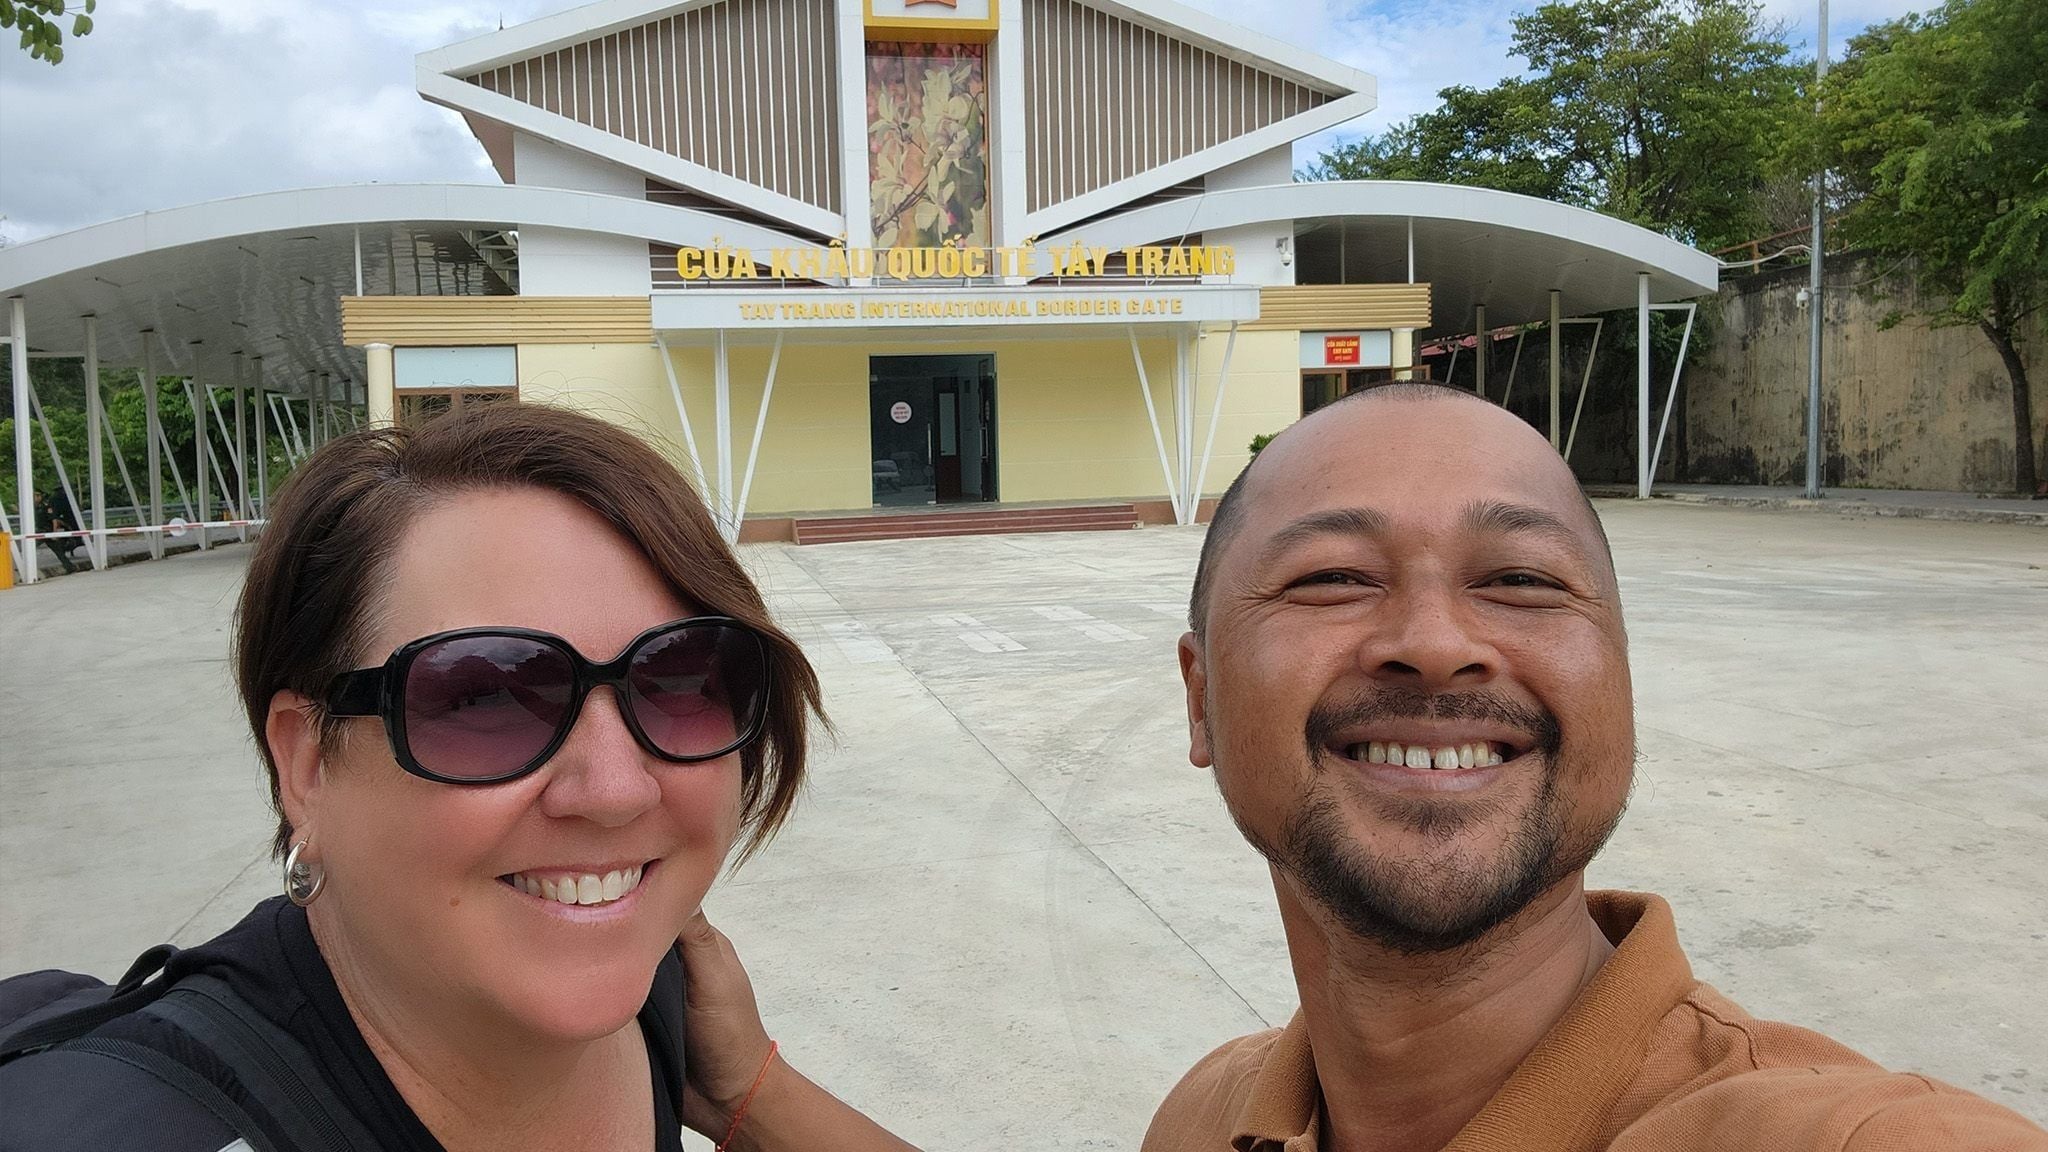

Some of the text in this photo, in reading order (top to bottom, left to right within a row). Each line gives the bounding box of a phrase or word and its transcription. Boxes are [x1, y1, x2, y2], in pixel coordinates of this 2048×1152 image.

[677, 231, 1235, 281] CỬA KHẨU QUỐC TẾ TÂY TRANG
[739, 298, 1184, 320] TAY TRANG INTERNATIONAL BORDER GATE
